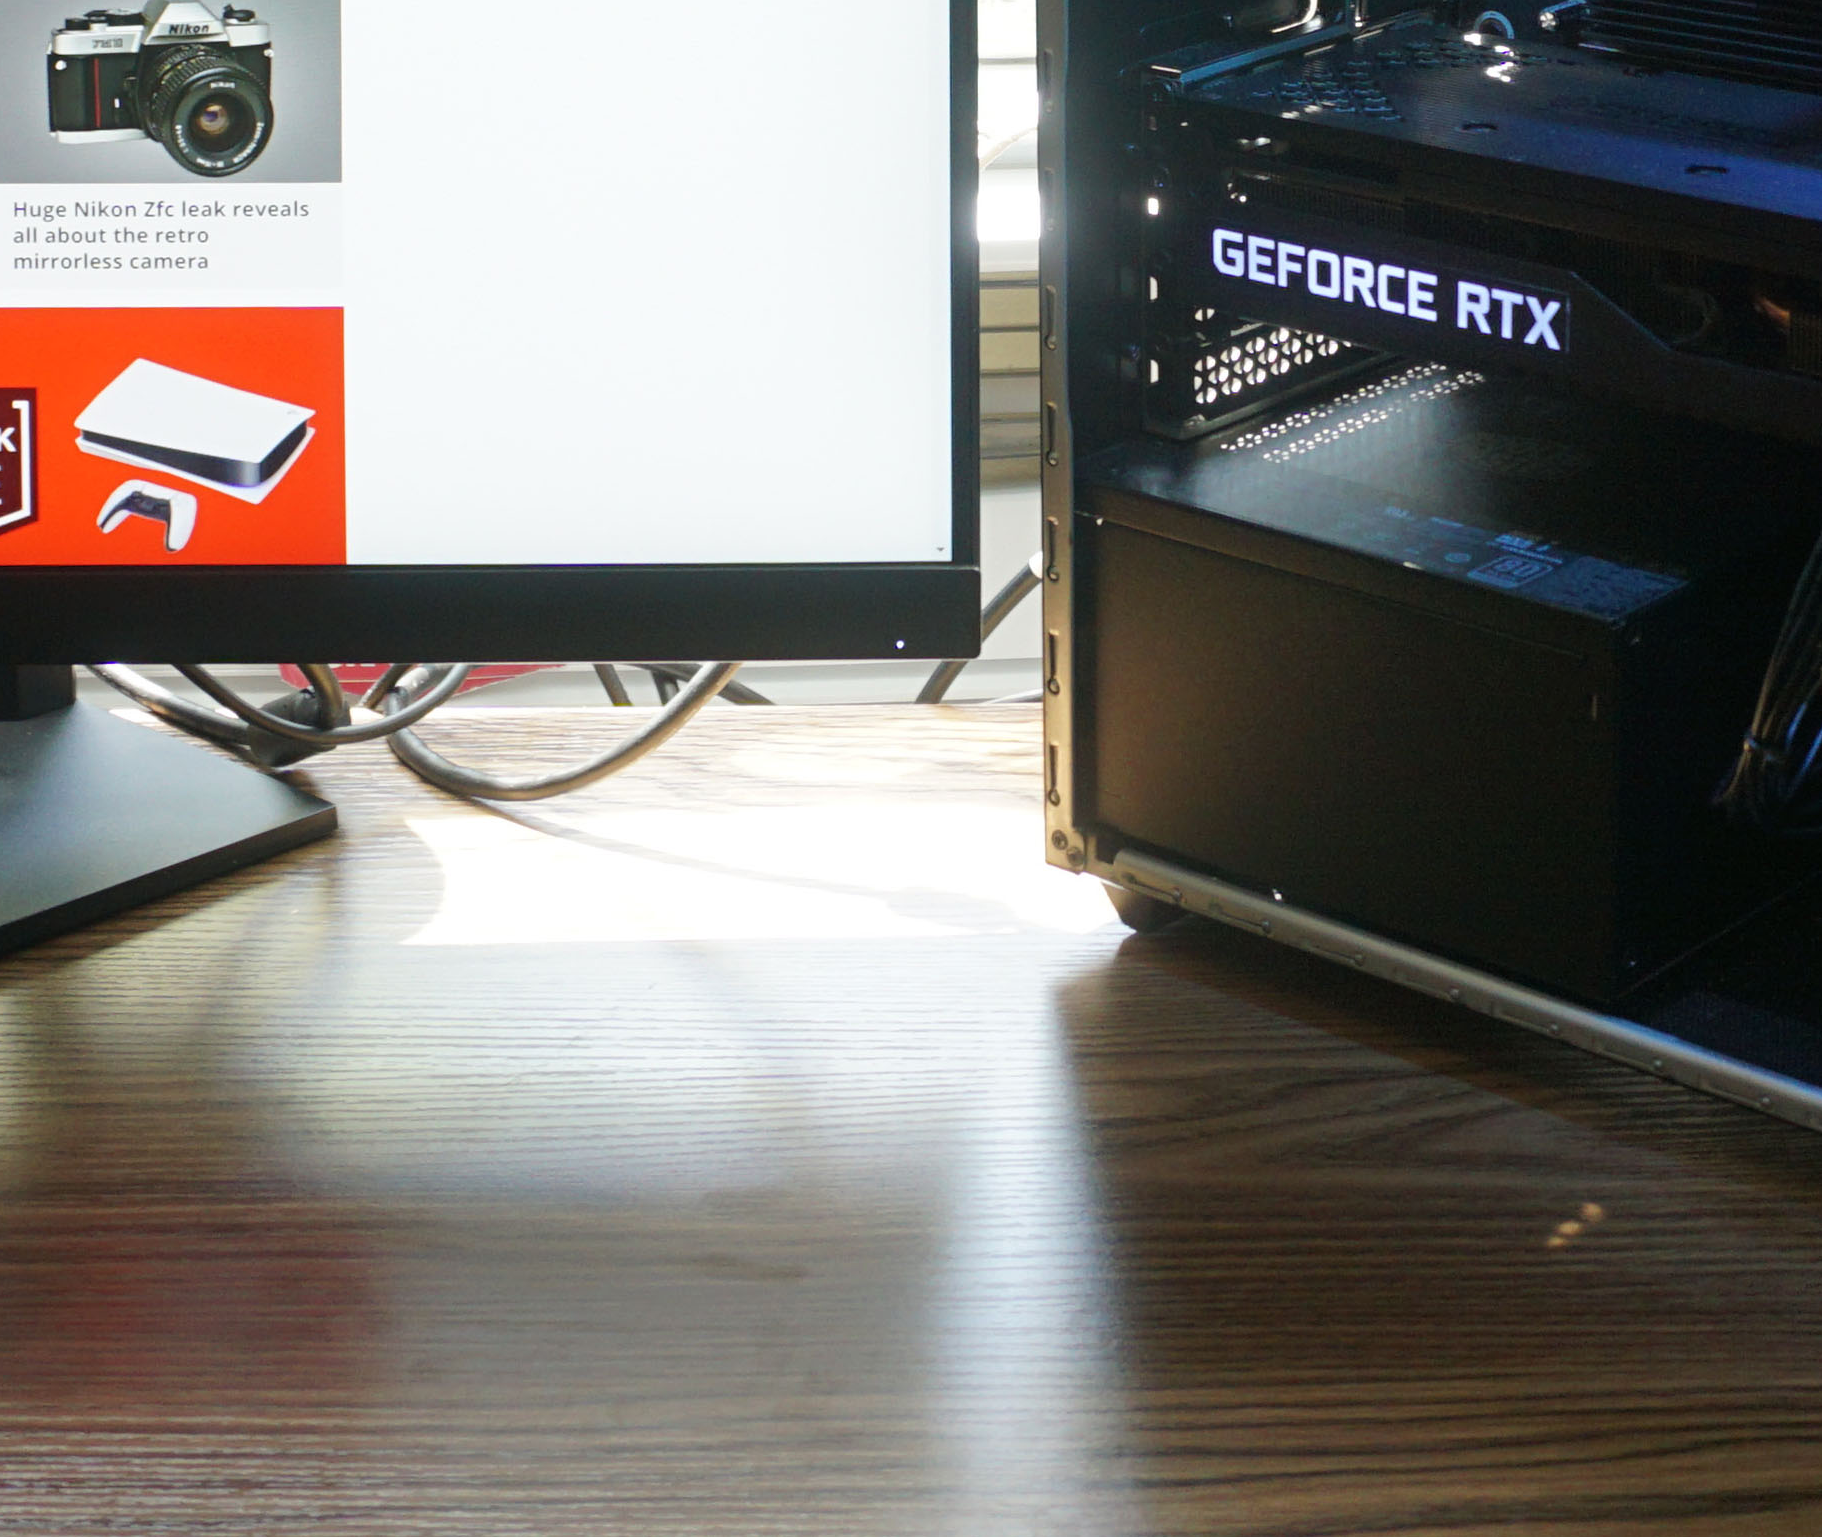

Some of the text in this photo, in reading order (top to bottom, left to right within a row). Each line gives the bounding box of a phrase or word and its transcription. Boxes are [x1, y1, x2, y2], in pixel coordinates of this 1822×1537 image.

[168, 24, 210, 35] Nikon
[13, 200, 310, 223] Huge Nikon Zfc leak reveals
[13, 227, 209, 243] all about the retro
[13, 252, 210, 270] mirrorless camera
[1212, 227, 1562, 352] GEFORCE RTX
